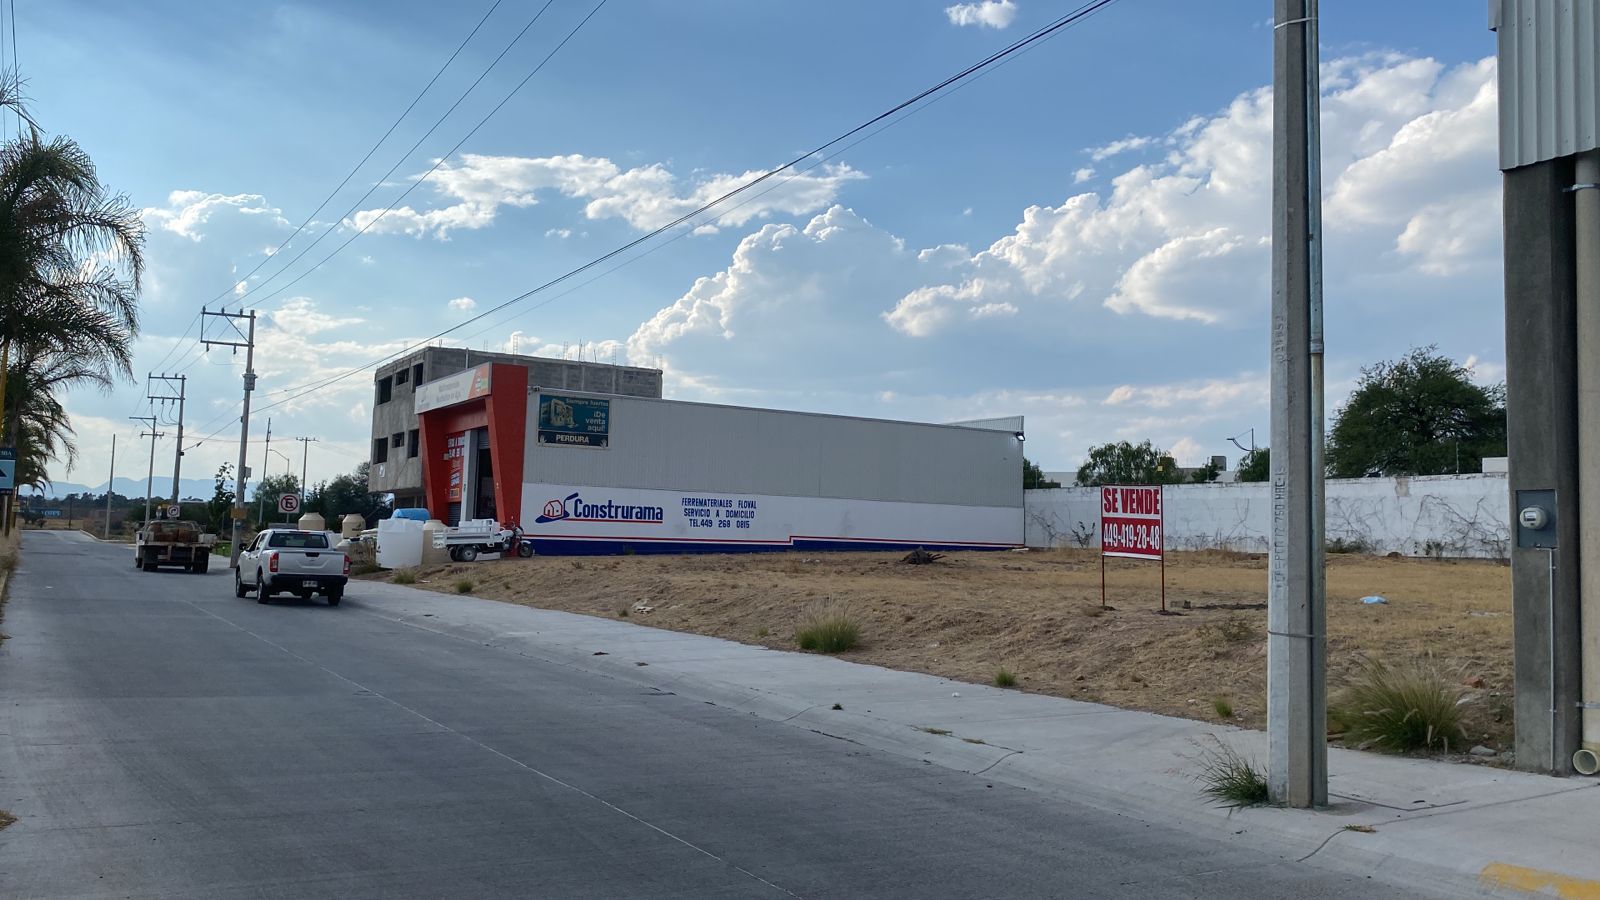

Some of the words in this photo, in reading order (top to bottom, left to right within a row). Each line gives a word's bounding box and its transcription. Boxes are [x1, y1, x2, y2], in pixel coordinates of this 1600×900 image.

[555, 434, 590, 443] PERDURA
[681, 497, 733, 508] FERREMATERIALES
[737, 500, 757, 509] FLOVAL
[1104, 488, 1118, 513] SE
[1120, 488, 1160, 515] VENDE
[574, 498, 664, 521] Construrama
[683, 507, 711, 518] SERVICIO
[716, 509, 720, 518] A
[725, 510, 755, 519] DOMICILIO
[718, 519, 731, 528] 268
[1103, 523, 1160, 550] 449-419-28-48
